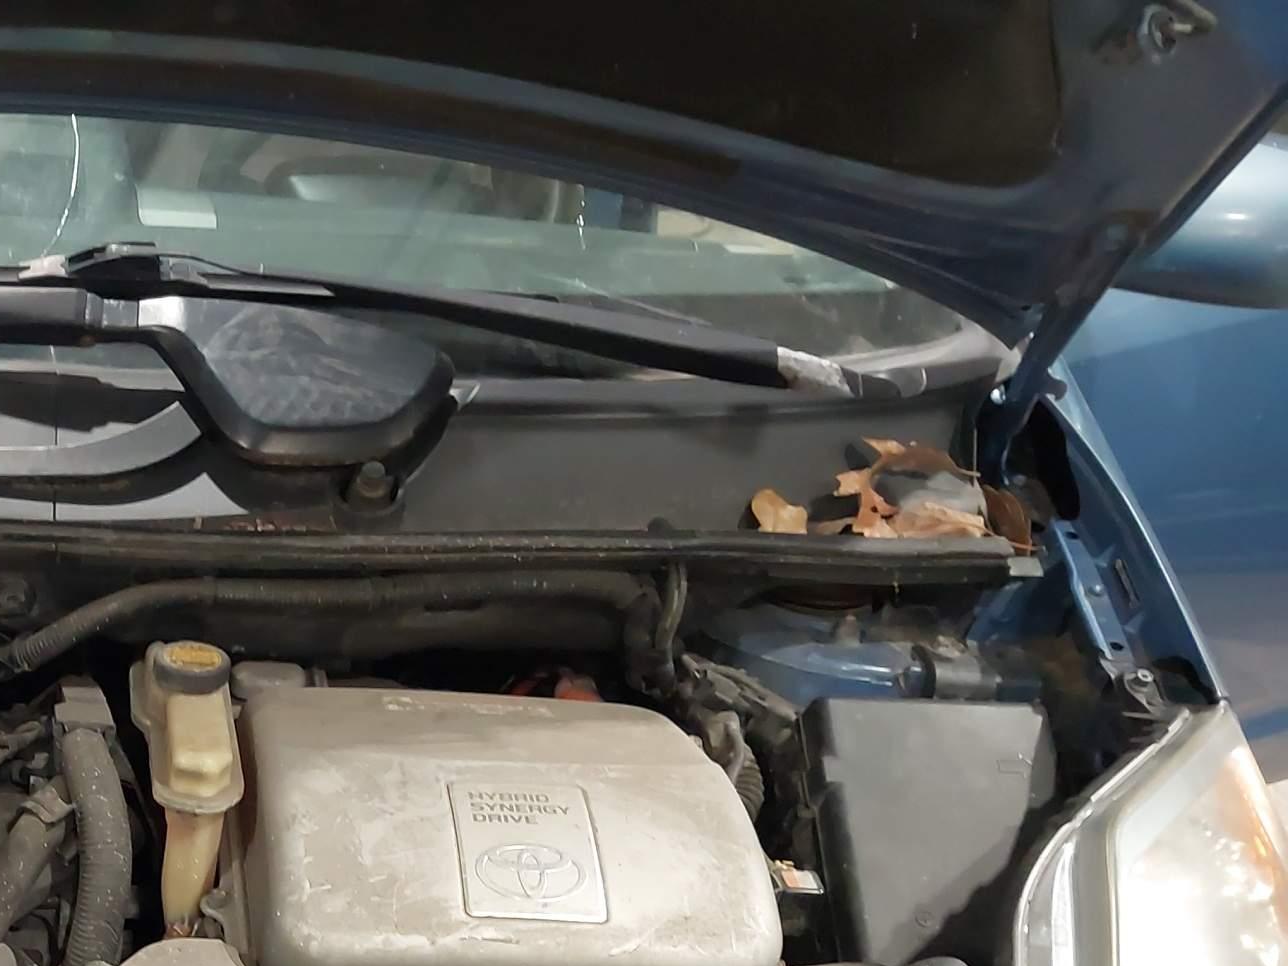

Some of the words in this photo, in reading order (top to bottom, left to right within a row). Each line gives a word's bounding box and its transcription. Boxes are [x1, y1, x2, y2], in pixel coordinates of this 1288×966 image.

[467, 791, 550, 803] HYBRID
[470, 802, 569, 815] SYNERGY
[472, 813, 539, 825] DRIVE
